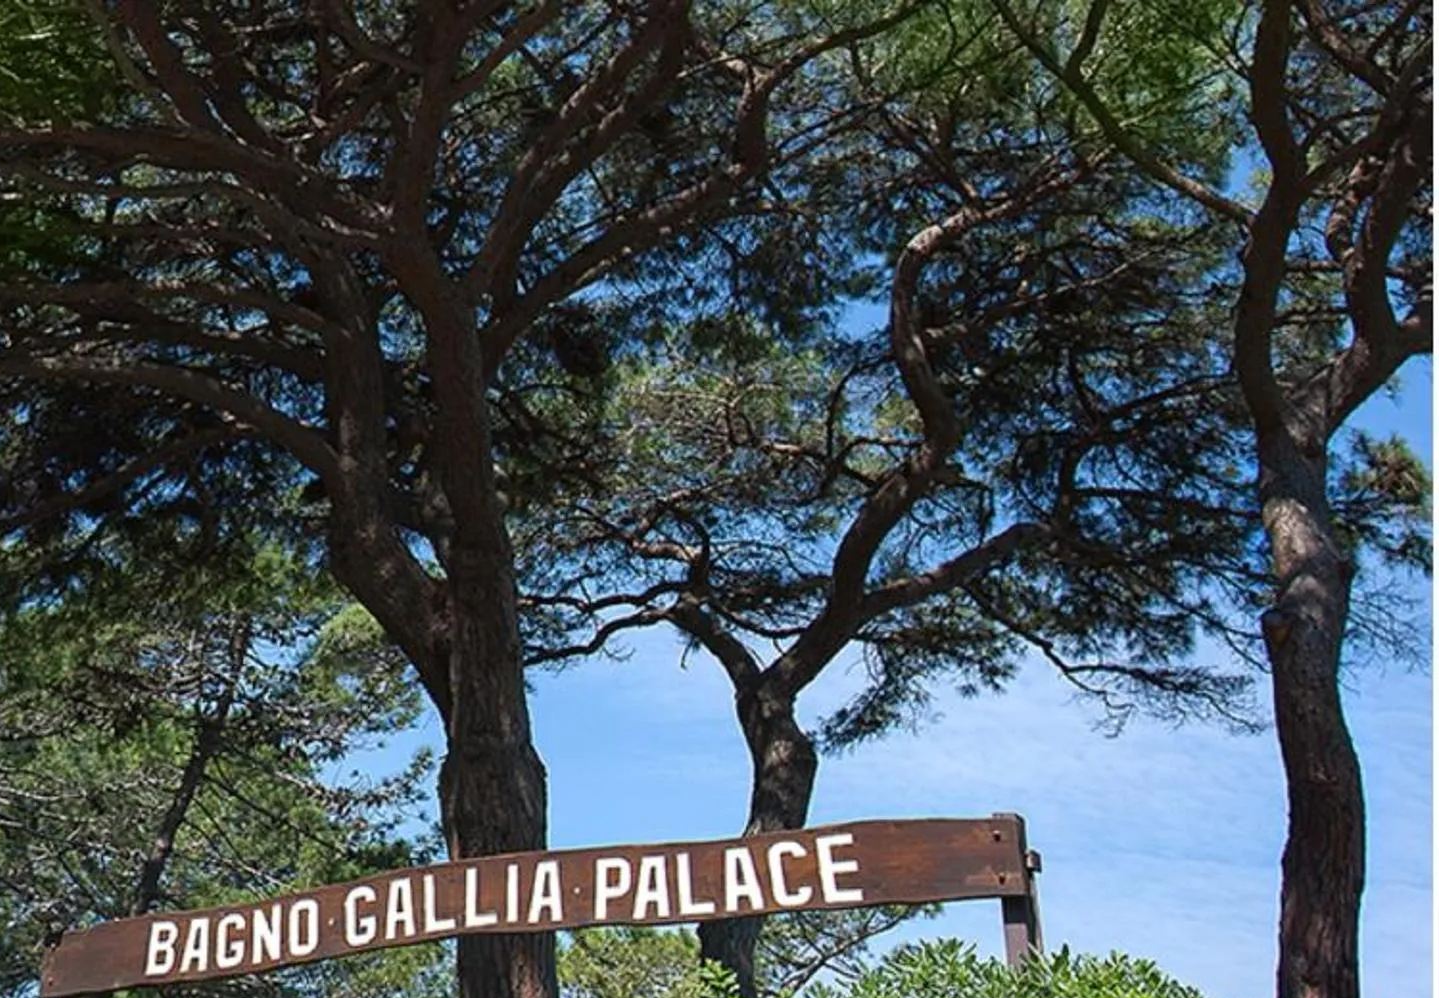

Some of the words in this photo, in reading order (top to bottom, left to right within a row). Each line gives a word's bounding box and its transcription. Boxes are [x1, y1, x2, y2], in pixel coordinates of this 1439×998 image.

[145, 900, 320, 976] BAGNO
[344, 860, 561, 946] GALLIA
[594, 833, 864, 921] PALACE
